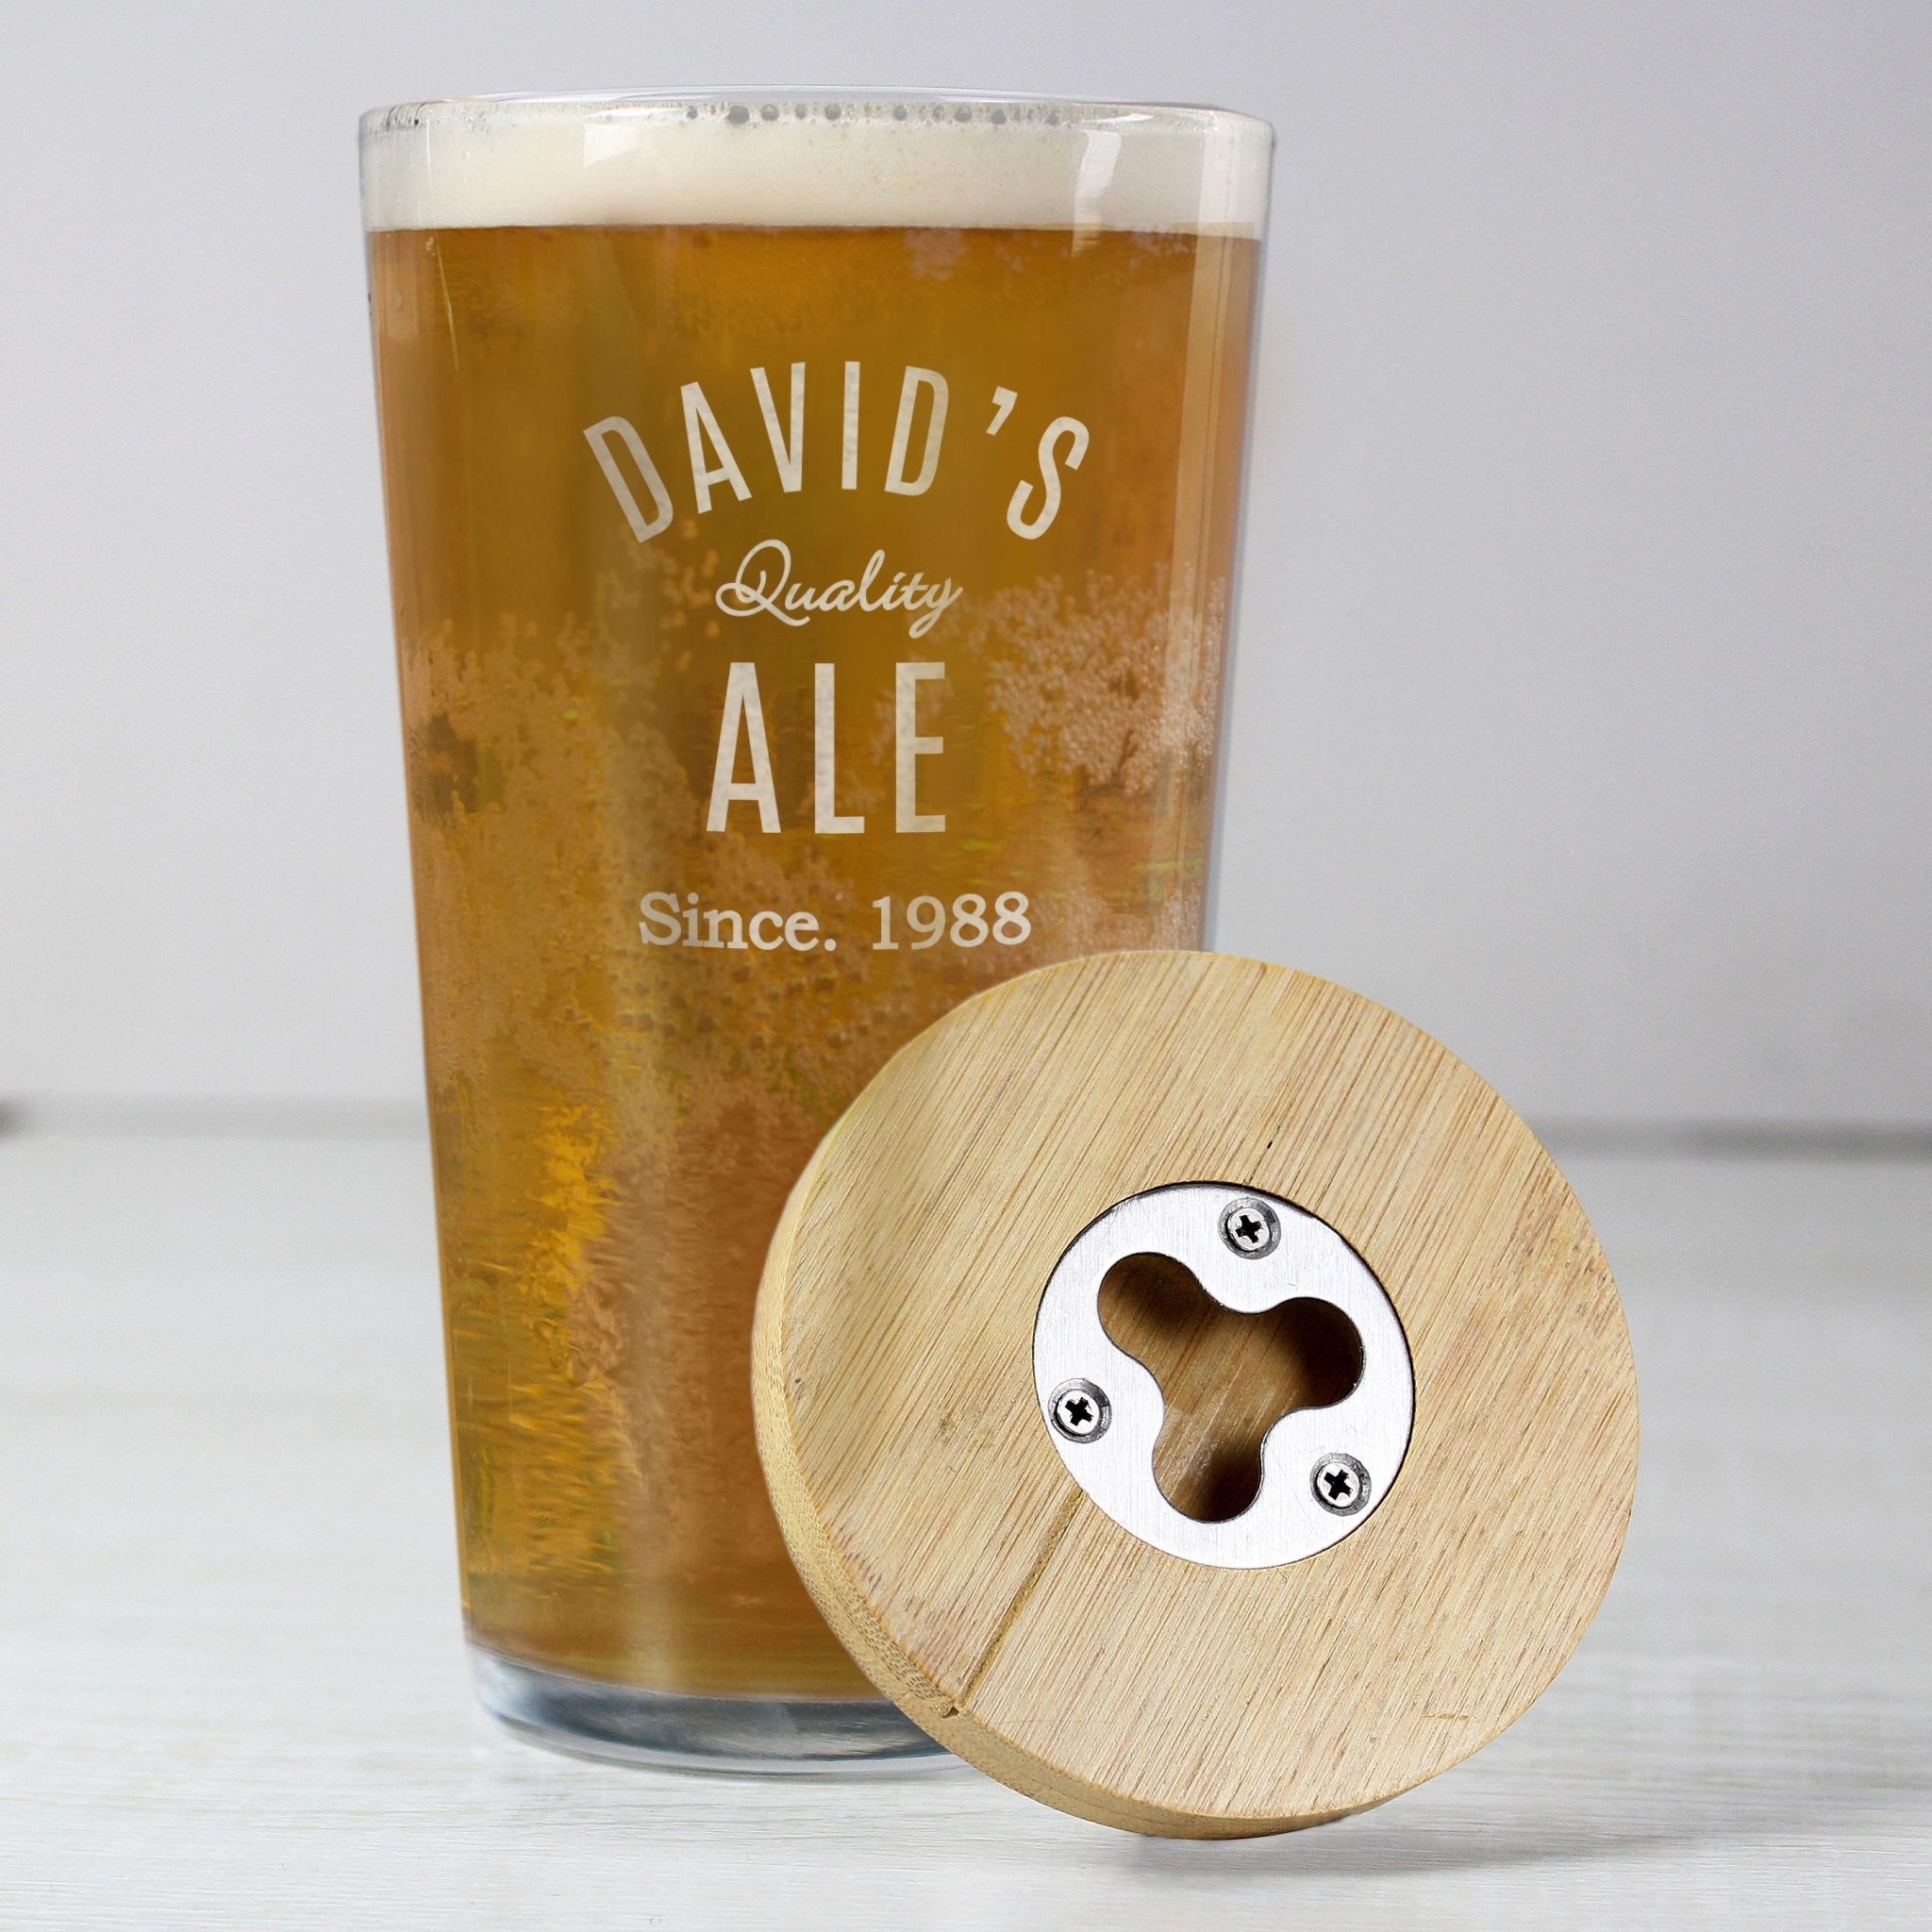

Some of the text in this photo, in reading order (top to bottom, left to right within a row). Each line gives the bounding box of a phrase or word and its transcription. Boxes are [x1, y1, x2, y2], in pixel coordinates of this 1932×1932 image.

[583, 361, 1090, 543] DAVID'S
[715, 539, 963, 638] Quality
[706, 661, 945, 834] ALE
[639, 891, 1031, 951] Since. 1988
